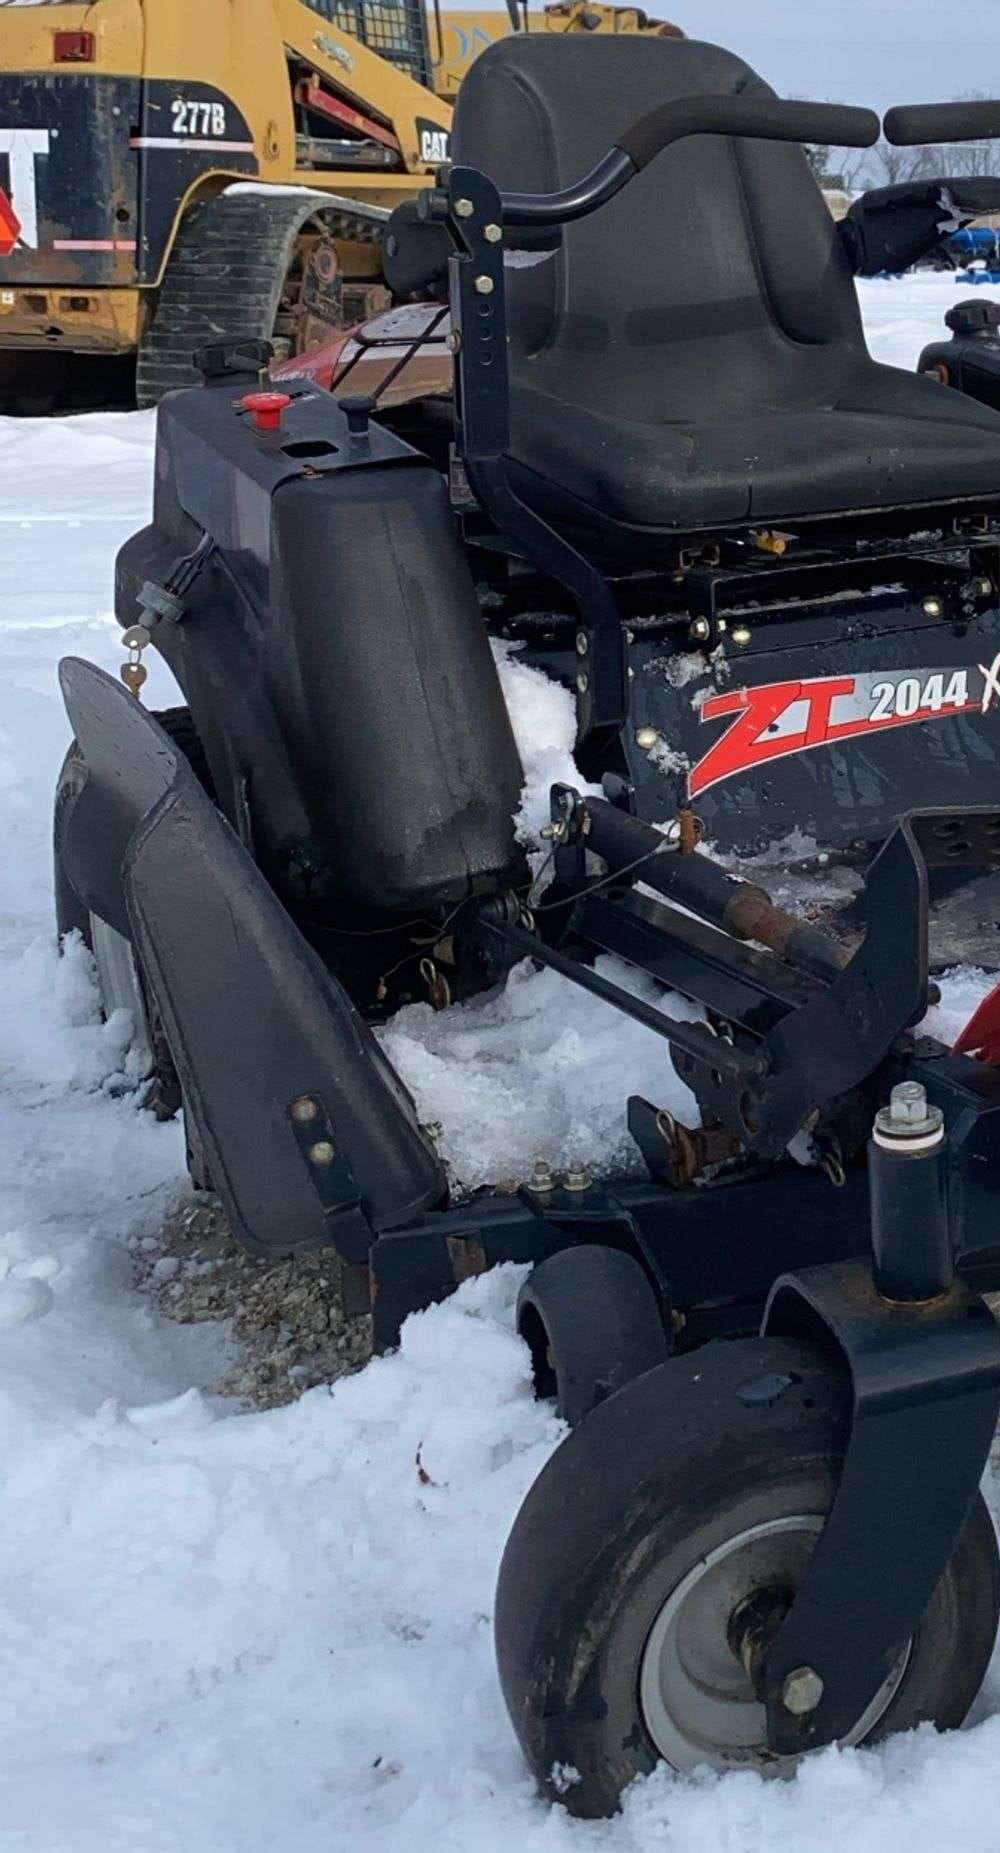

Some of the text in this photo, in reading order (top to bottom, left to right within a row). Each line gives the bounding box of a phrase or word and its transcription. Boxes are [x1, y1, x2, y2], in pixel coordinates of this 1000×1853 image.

[171, 101, 226, 135] 277B
[689, 678, 855, 798] ZT
[869, 670, 969, 722] 2044
